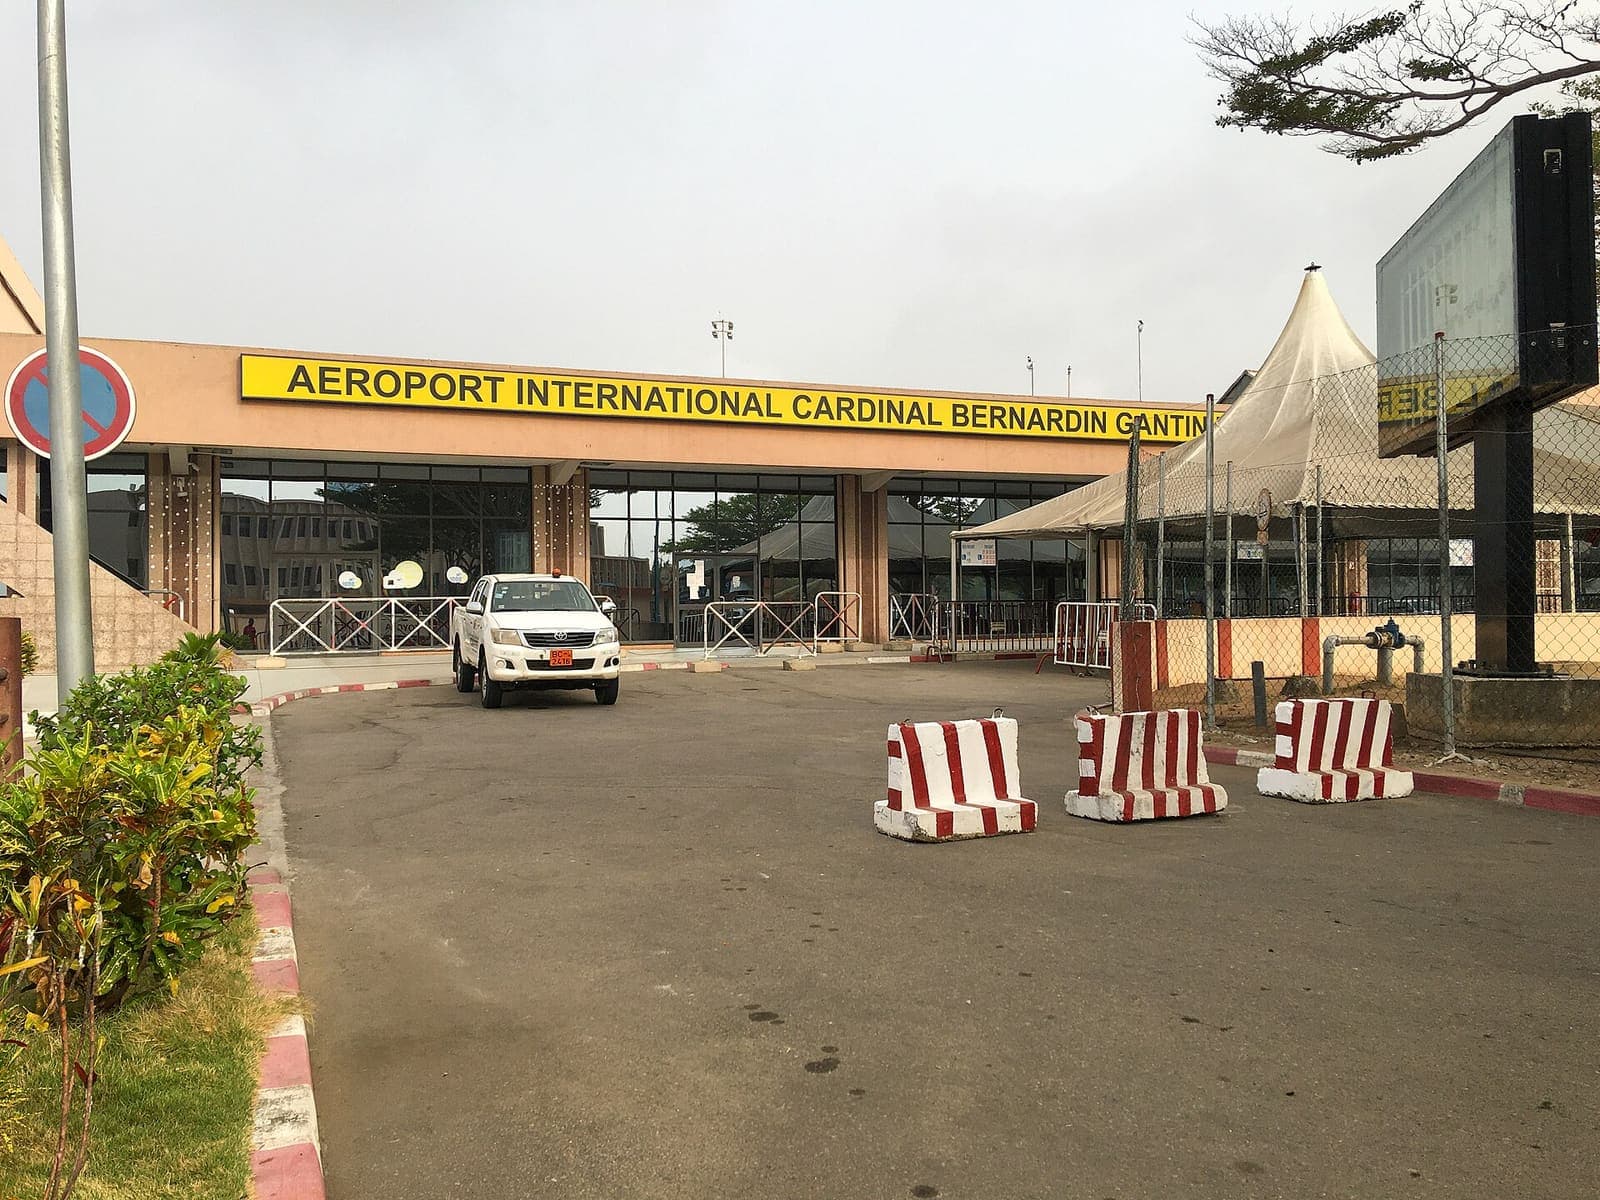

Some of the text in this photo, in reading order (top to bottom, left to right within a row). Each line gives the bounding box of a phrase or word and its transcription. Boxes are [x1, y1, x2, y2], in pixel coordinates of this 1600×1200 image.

[287, 364, 504, 403] AEROPORT
[517, 378, 782, 418] INTERNATIONAL
[792, 394, 942, 425] CARDINAL
[952, 403, 1107, 433] BERNARDIN
